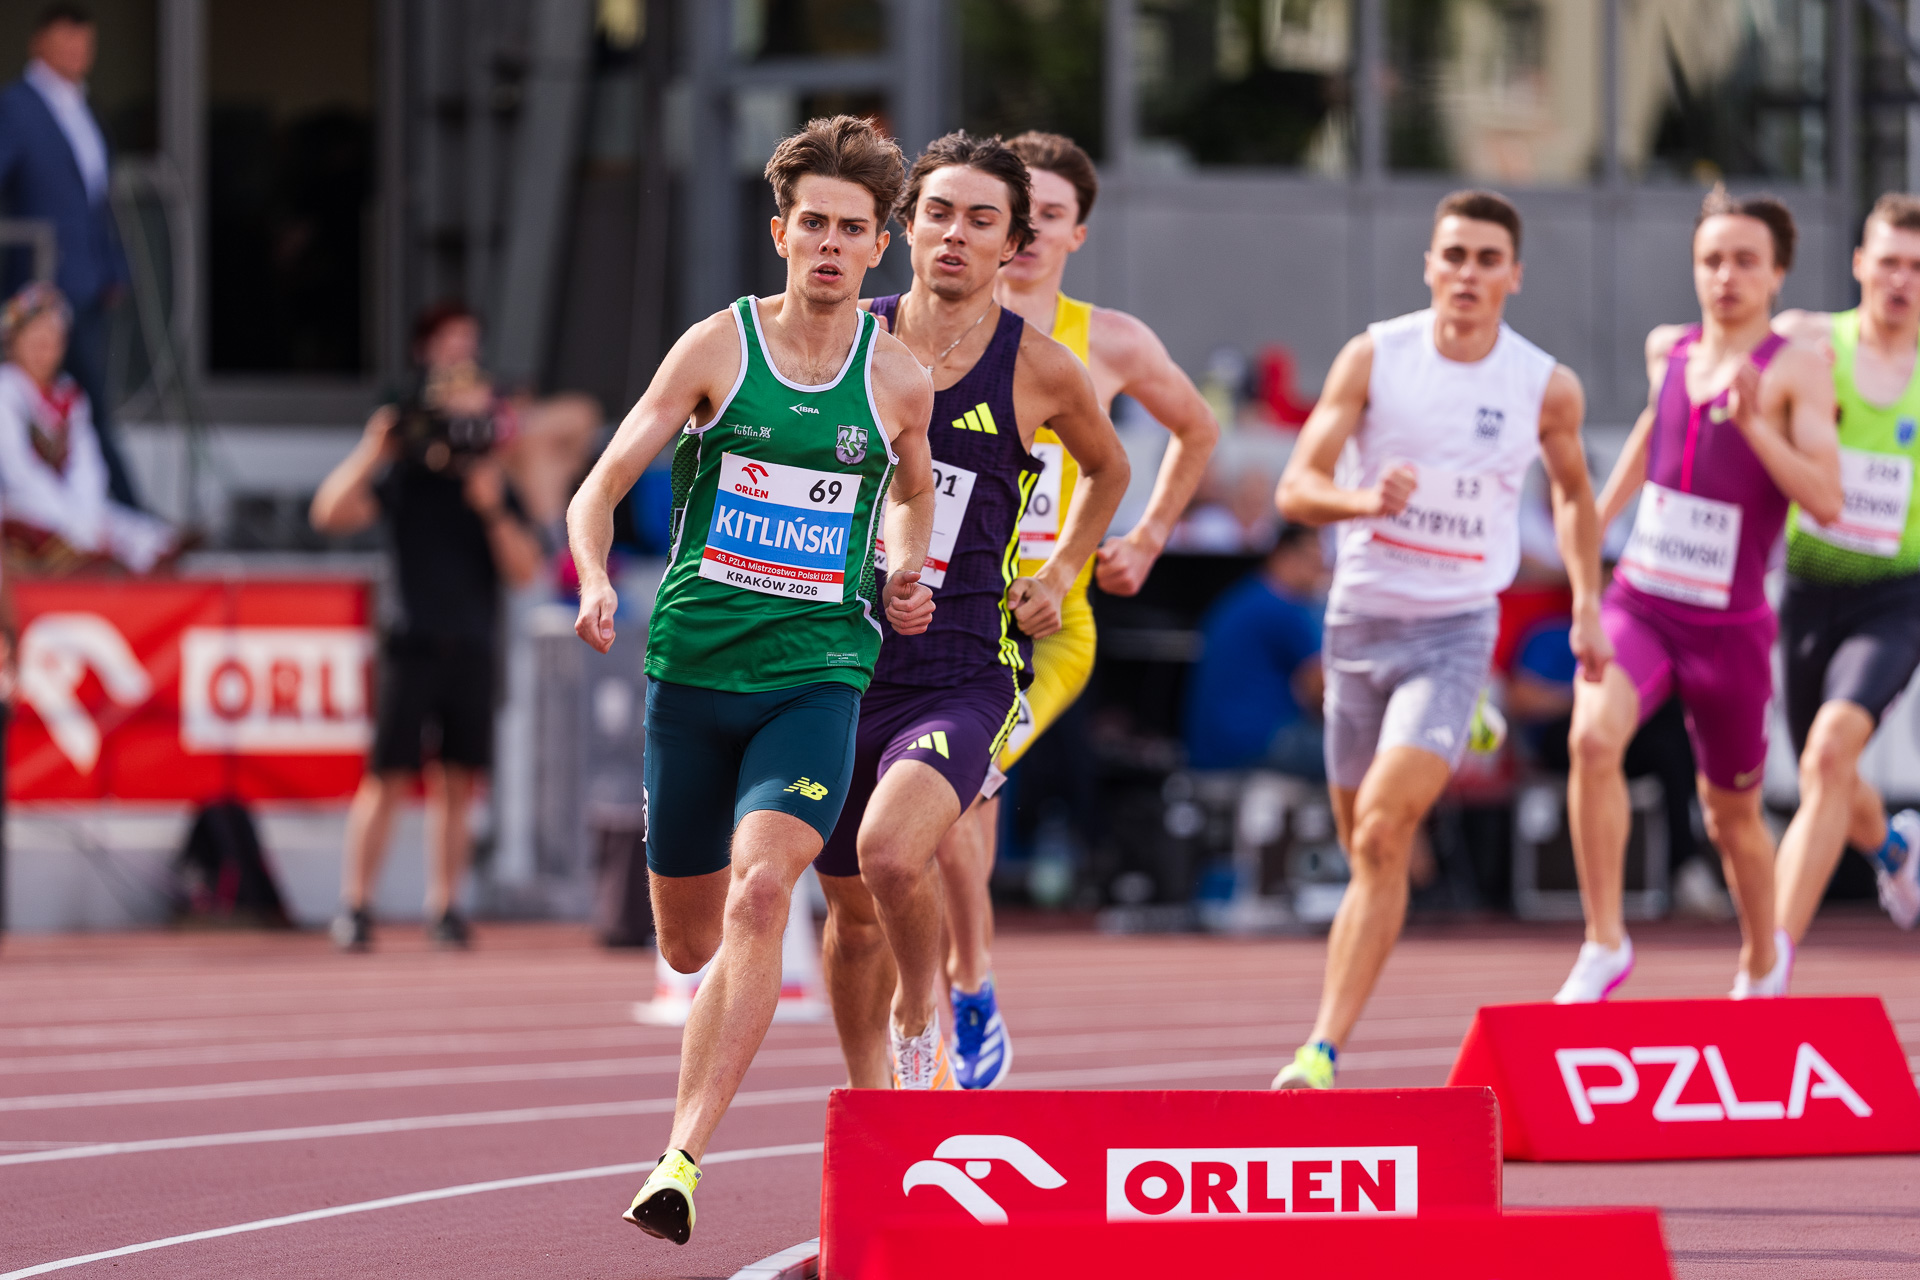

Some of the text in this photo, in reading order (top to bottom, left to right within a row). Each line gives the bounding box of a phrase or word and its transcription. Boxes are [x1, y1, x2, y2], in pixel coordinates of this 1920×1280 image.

[735, 483, 769, 499] ORLEN
[809, 479, 843, 504] 69
[715, 505, 845, 555] KITLIŃSKI
[716, 553, 833, 582] 43. PZLA Mistrzostwa Polski U23
[726, 570, 818, 596] KRAKÓW 2026
[1555, 1042, 1873, 1125] PZLA
[1124, 1159, 1396, 1215] ORLEN
